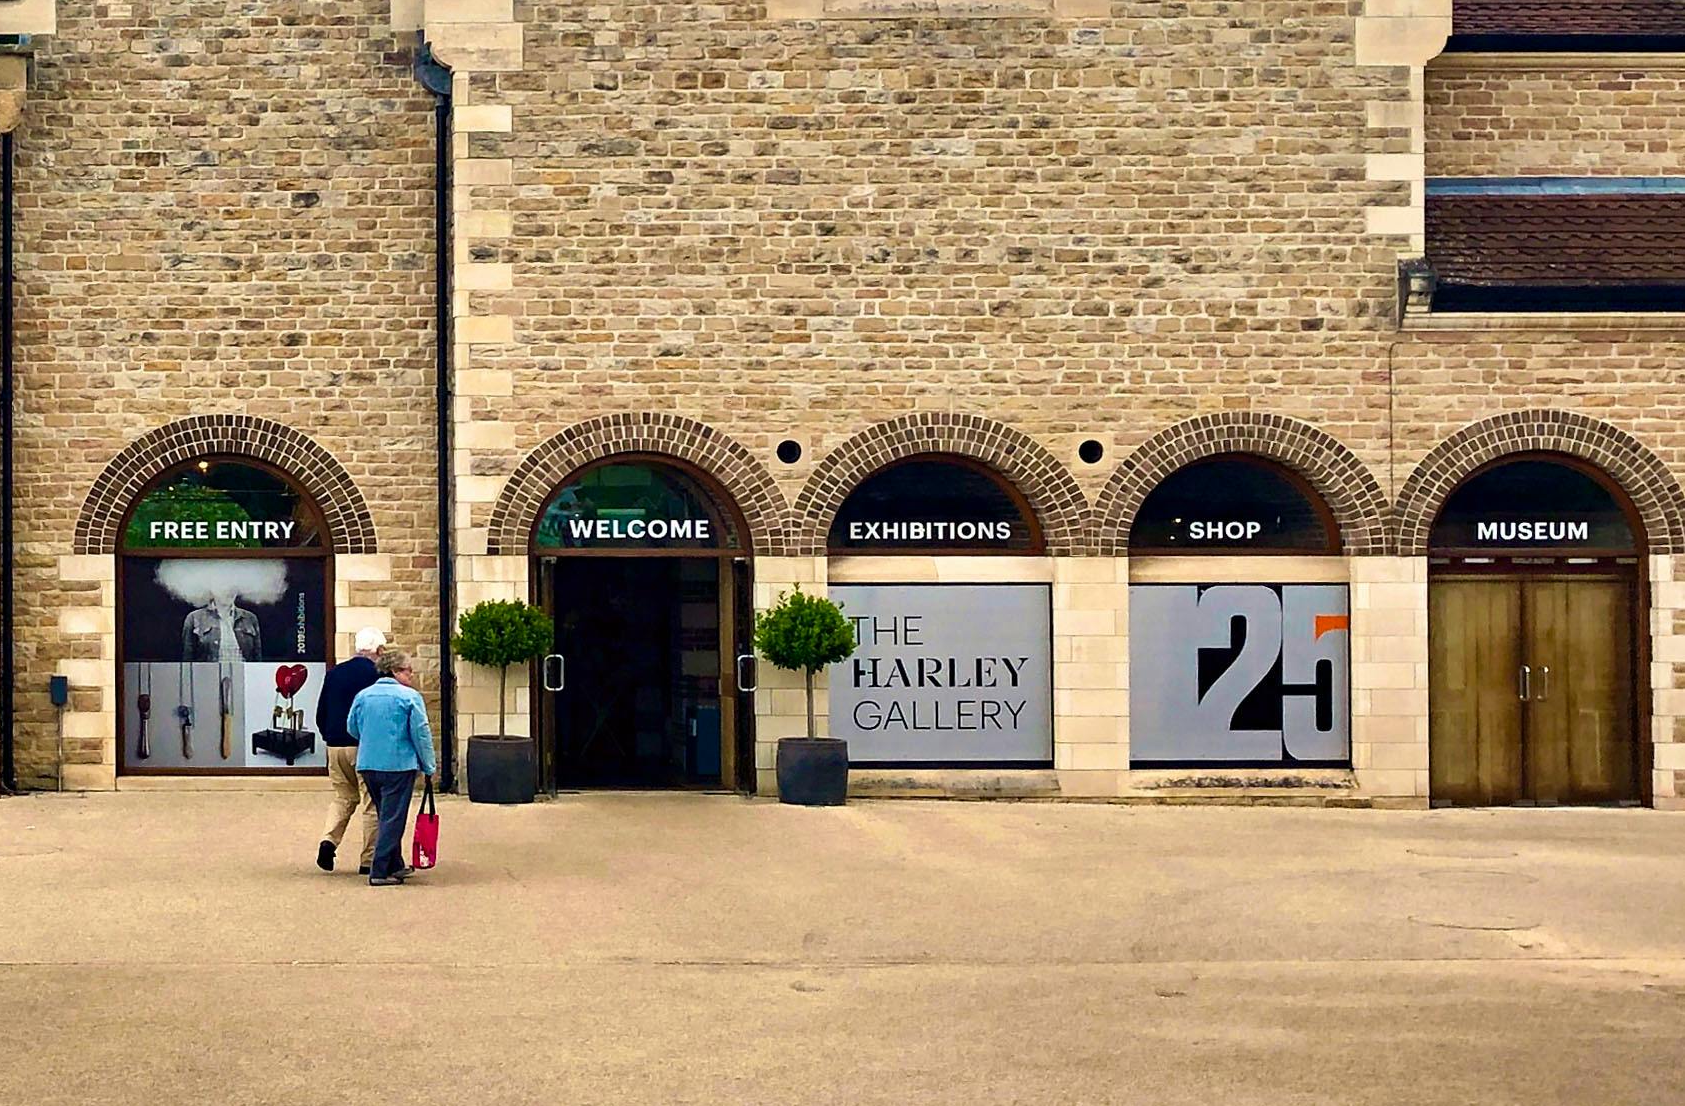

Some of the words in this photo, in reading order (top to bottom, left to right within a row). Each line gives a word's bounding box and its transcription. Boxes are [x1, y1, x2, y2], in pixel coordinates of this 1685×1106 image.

[150, 521, 209, 539] FREE
[216, 521, 295, 539] ENTRY
[569, 519, 710, 539] WELCOME
[850, 521, 1011, 540] EXHIBITIONS
[1189, 521, 1261, 539] SHOP
[1477, 522, 1588, 540] MUSEUM
[848, 616, 923, 645] THE
[853, 657, 1029, 687] HARLEY
[1197, 585, 1349, 761] 25
[853, 700, 1027, 730] GALLERY
